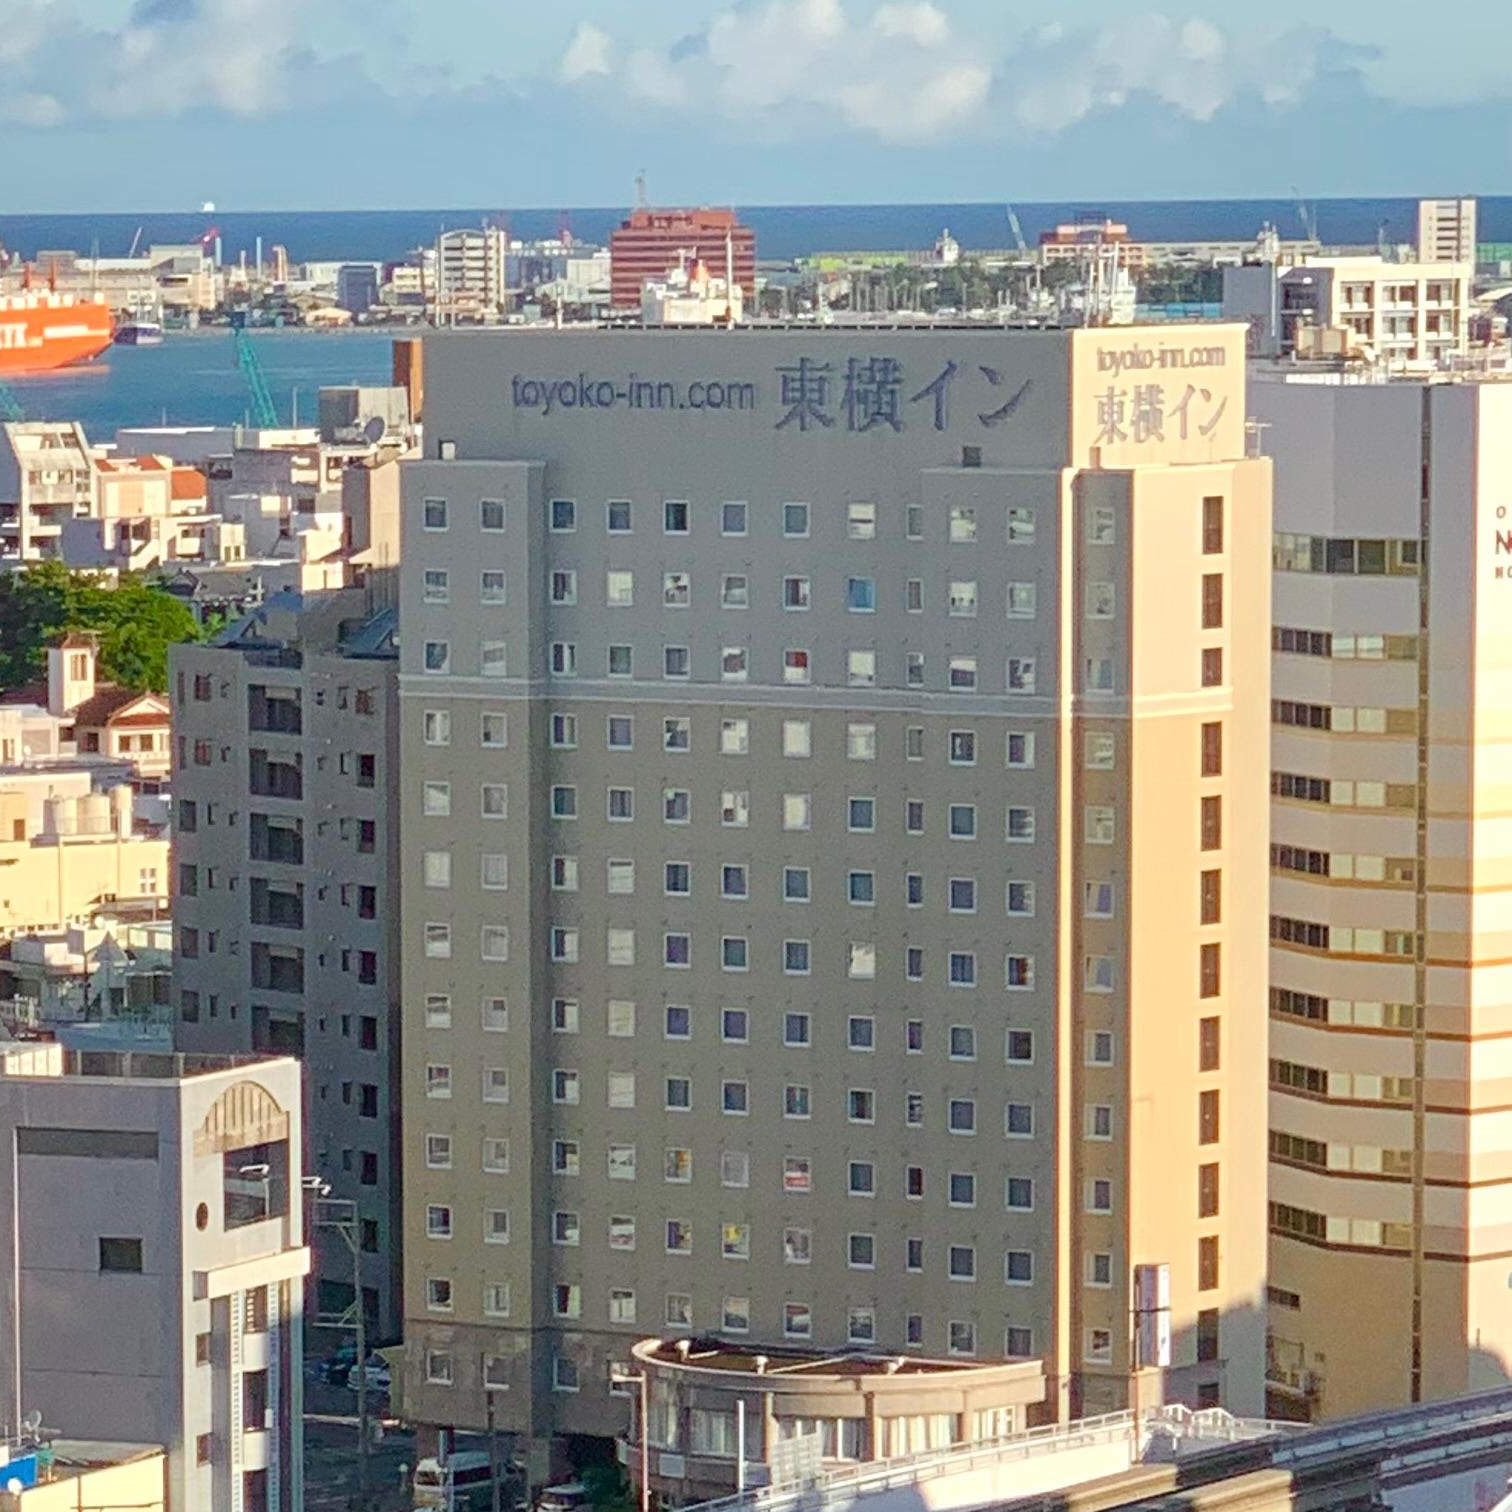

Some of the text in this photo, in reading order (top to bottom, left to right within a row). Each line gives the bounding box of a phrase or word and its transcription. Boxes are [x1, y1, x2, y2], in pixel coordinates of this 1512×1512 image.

[511, 372, 756, 416] toyoko-inn.com
[774, 357, 1034, 433] 東横イン
[1093, 383, 1228, 445] 東横イン
